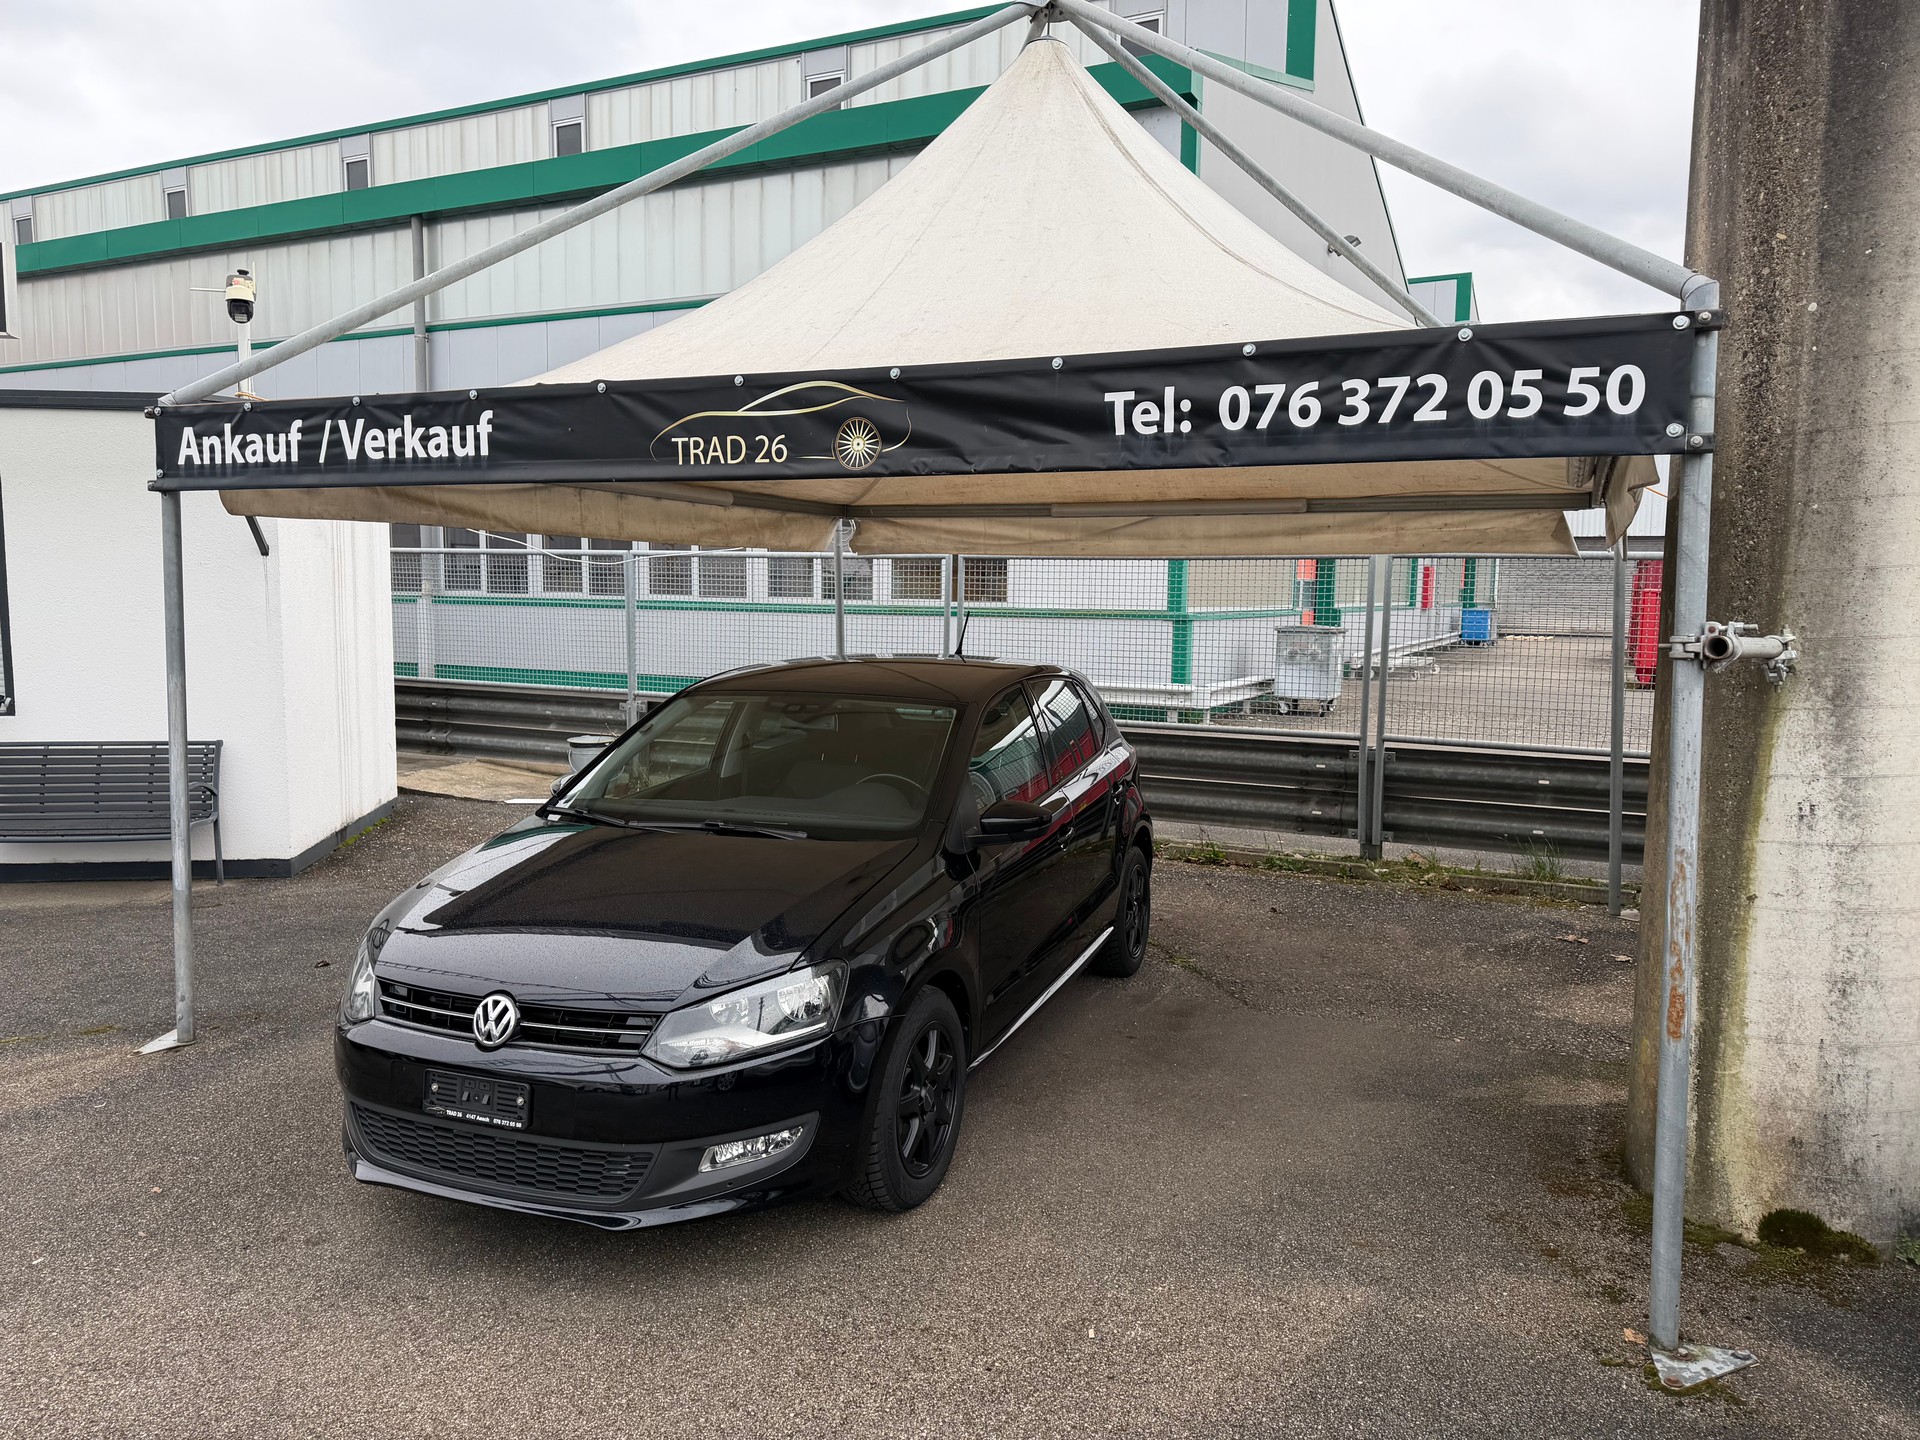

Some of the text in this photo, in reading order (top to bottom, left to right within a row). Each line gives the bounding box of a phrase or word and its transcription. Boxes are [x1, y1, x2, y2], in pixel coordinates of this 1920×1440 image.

[1104, 364, 1646, 436] Tel: 076 372 05 50
[177, 419, 303, 465] Ankauf
[671, 434, 788, 466] TRAD 26
